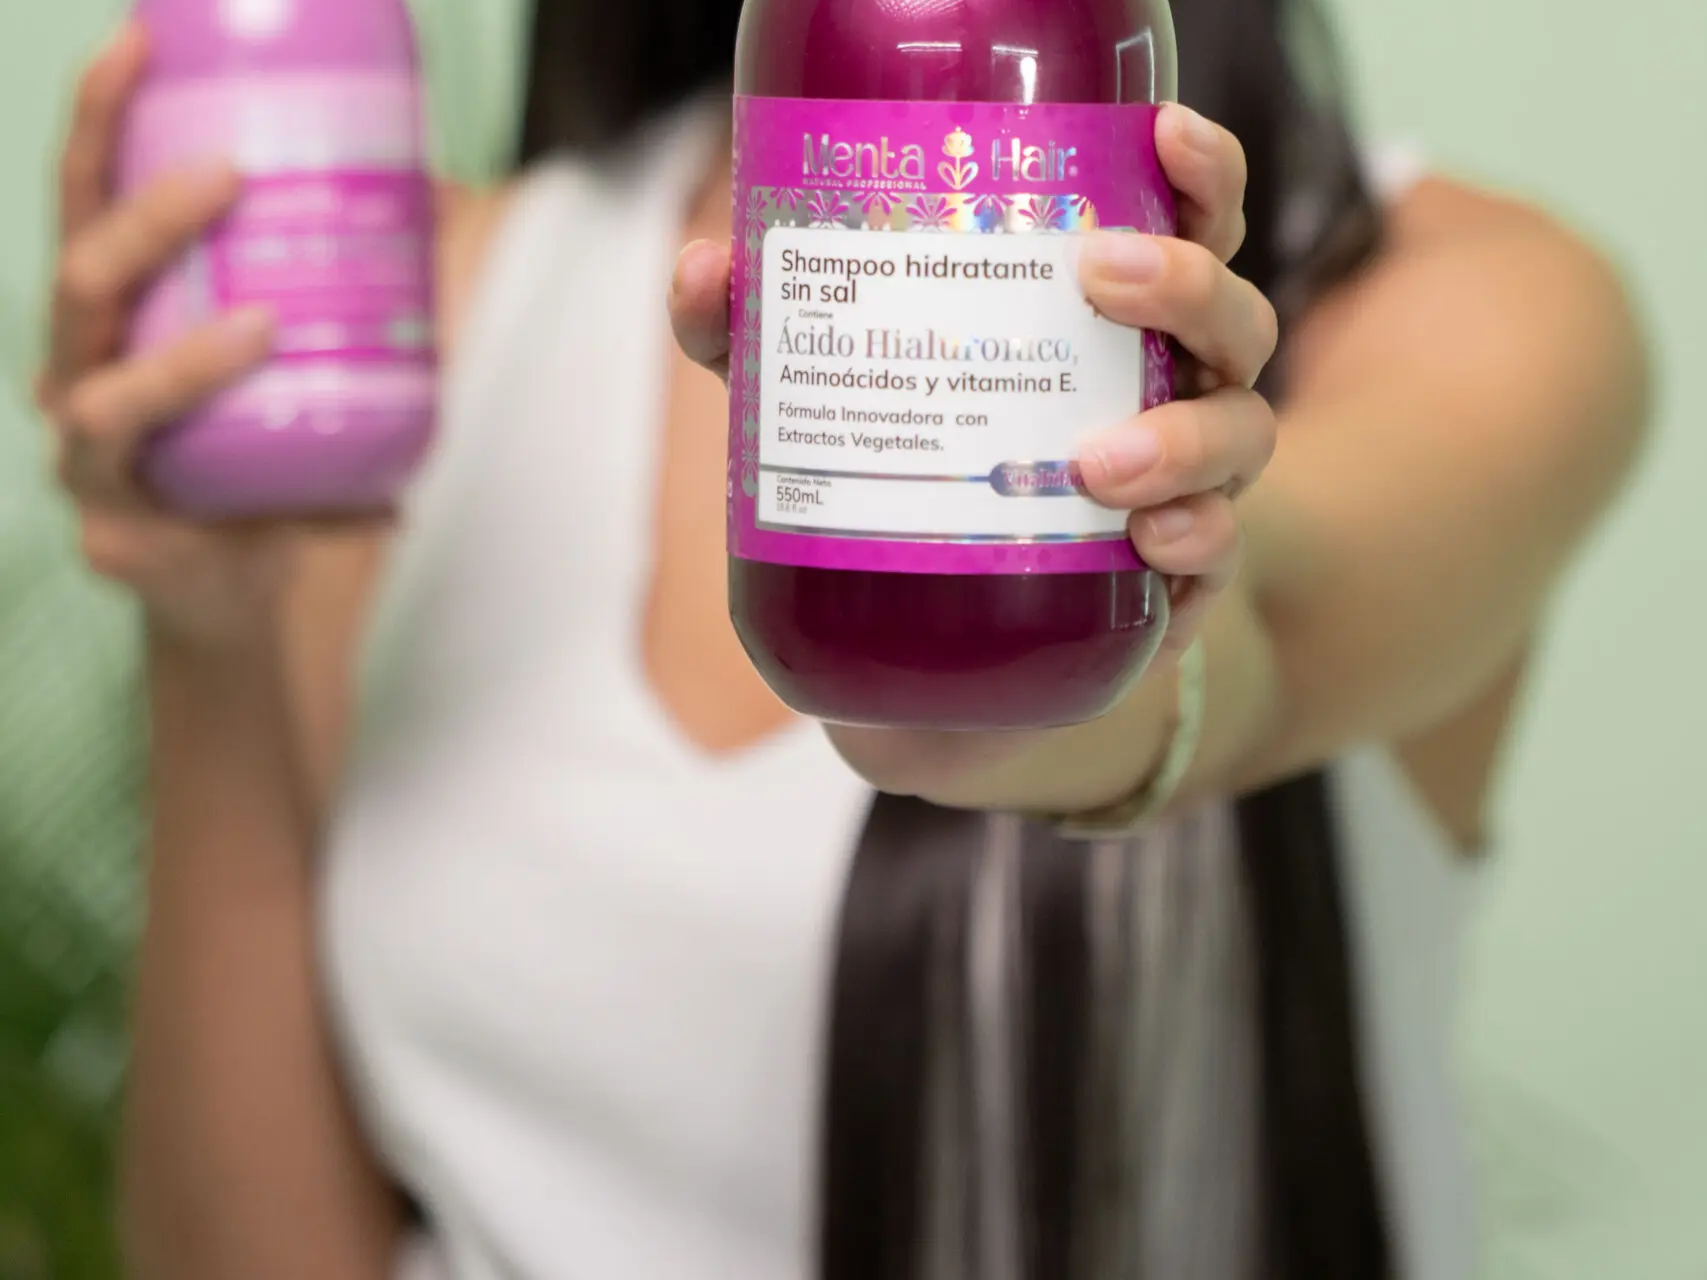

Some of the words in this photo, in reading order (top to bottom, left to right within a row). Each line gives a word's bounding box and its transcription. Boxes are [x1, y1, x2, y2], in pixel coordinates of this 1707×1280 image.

[803, 133, 925, 180] Menta
[781, 249, 896, 281] Shampoo
[905, 254, 1054, 280] hidratante
[781, 277, 811, 301] sin
[820, 279, 857, 304] sal
[798, 309, 834, 320] Contiene
[776, 317, 855, 358] Ácido
[779, 365, 917, 392] Aminoácidos
[925, 375, 939, 396] y
[947, 372, 1052, 393] vitamina
[1059, 373, 1077, 393] E.
[778, 402, 836, 422] Fórmula
[841, 406, 944, 426] Innovadora
[955, 412, 988, 427] con
[778, 426, 845, 447] Extractos
[850, 432, 944, 453] Vegetales.
[776, 485, 824, 505] 550mL
